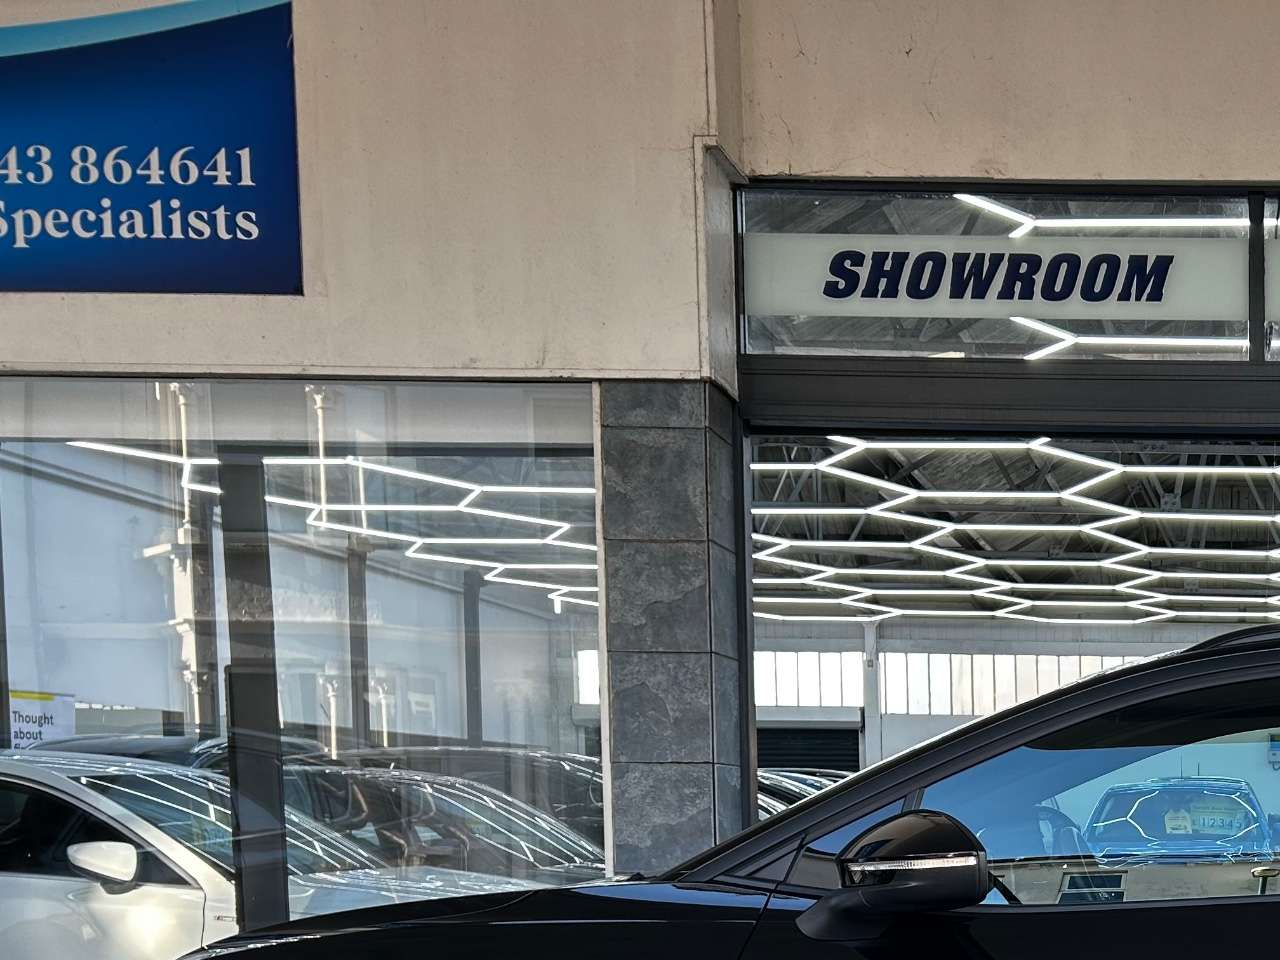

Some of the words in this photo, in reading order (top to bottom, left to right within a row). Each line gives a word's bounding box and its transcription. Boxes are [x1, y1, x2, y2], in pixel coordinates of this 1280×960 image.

[0, 144, 54, 186] 43
[70, 144, 257, 187] 864641
[822, 249, 1175, 303] SHOWROOM
[12, 710, 54, 728] Thought
[13, 728, 43, 741] about
